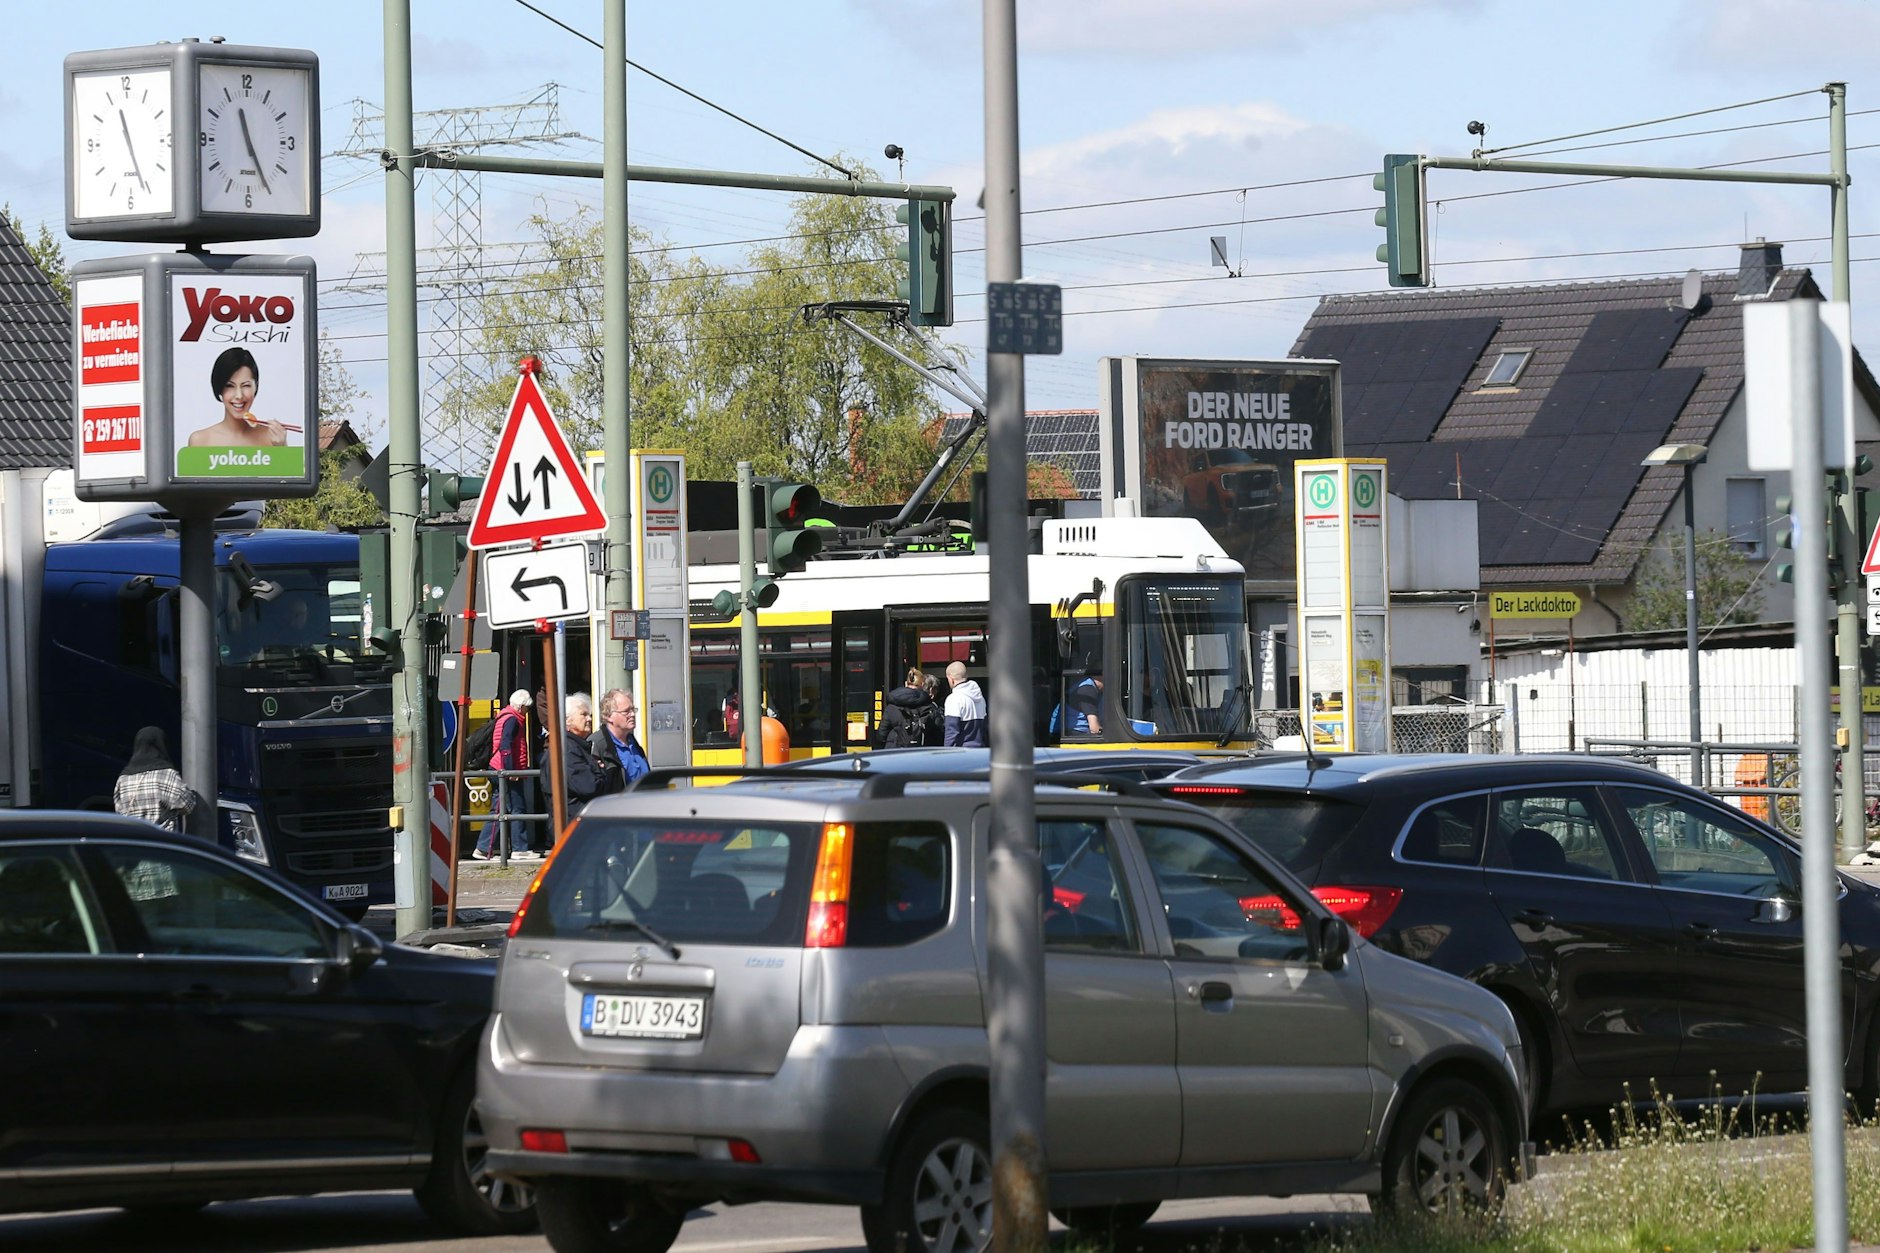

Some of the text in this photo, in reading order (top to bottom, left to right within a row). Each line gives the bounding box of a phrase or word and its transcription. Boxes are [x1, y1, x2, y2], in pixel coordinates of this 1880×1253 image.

[121, 76, 131, 91] 12
[241, 74, 253, 90] 12
[87, 138, 94, 153] 9
[200, 132, 207, 147] 9
[287, 136, 295, 151] 3
[127, 196, 134, 210] 6
[245, 194, 253, 209] 6
[82, 318, 139, 343] Werbefläche
[206, 324, 291, 344] Sushi
[83, 347, 139, 370] zu vermieten
[1187, 391, 1291, 420] DER NEUE
[95, 416, 140, 442] 259 267 111
[1165, 421, 1313, 450] FORD RANGER
[209, 450, 271, 470] yoko.de
[1495, 596, 1576, 612] Der Lackdoktor
[1260, 630, 1274, 691] STRÖER
[265, 742, 292, 750] VOLVO
[595, 1000, 606, 1024] B
[650, 1002, 700, 1028] 3943
